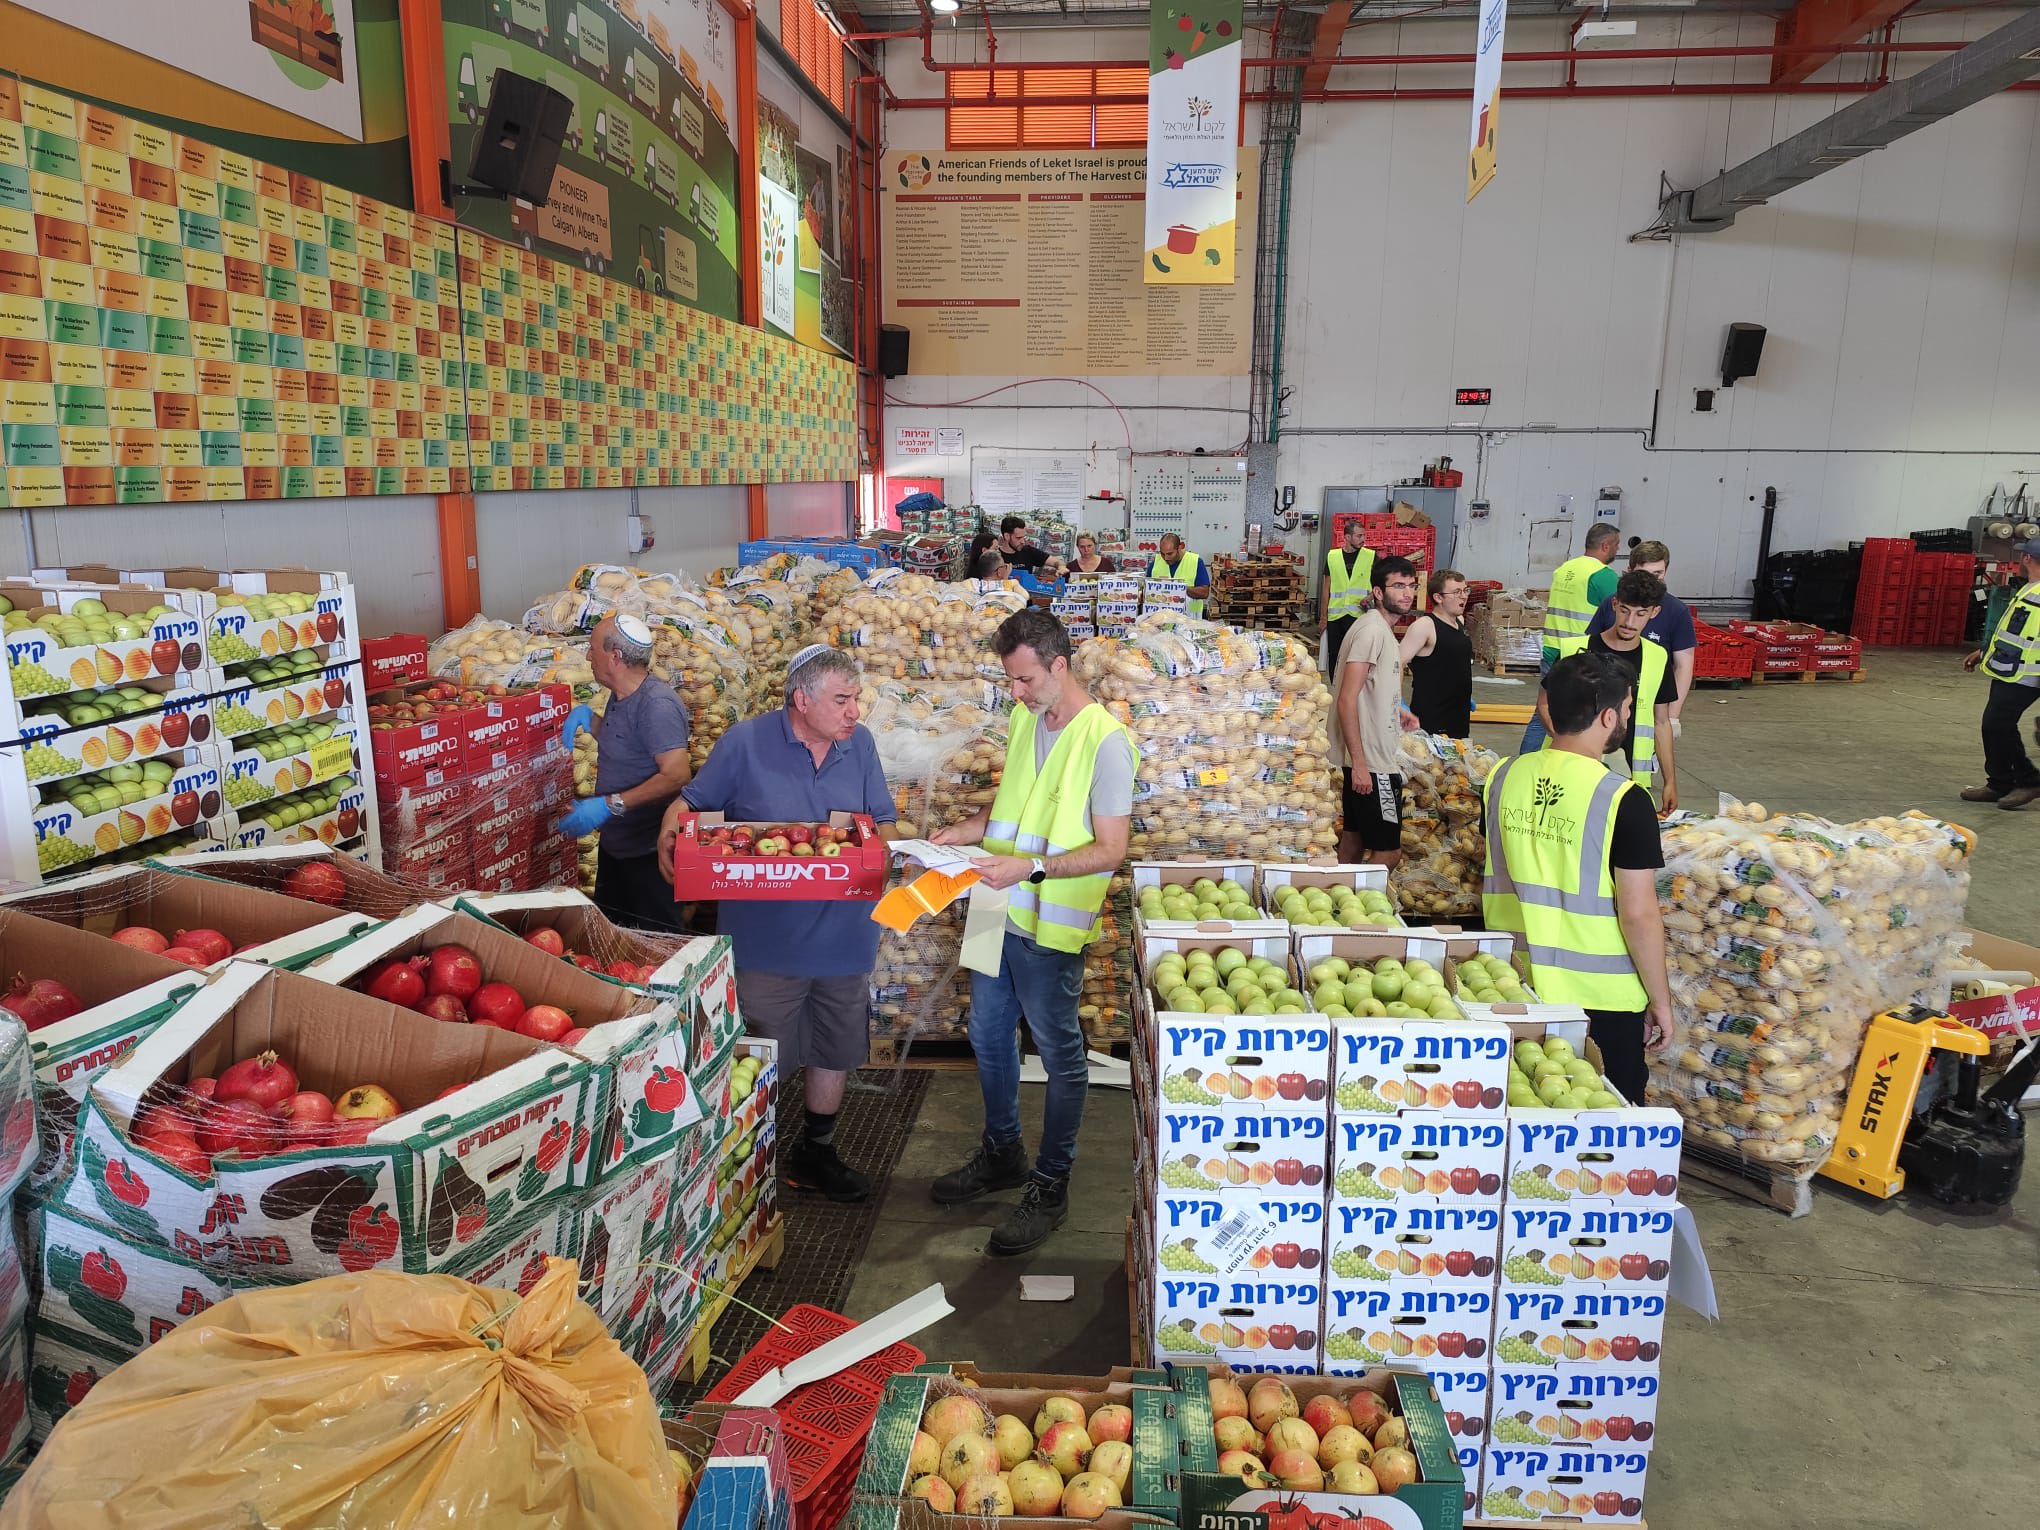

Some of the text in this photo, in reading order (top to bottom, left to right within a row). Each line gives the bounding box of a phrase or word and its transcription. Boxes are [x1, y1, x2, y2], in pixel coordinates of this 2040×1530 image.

[1163, 120, 1225, 134] לקט ישראל
[938, 157, 1147, 170] American Friends of Leket Israel is proud
[560, 181, 588, 203] PIONEER
[938, 172, 953, 182] the
[957, 172, 1001, 185] founding
[1005, 172, 1052, 182] members
[1056, 172, 1066, 181] of
[1068, 171, 1088, 181] The
[1091, 171, 1137, 181] Harvest
[1187, 175, 1219, 183] ישראל
[562, 202, 574, 216] and
[575, 206, 595, 224] Wynne
[552, 215, 599, 243] Calgary, Alberta
[1100, 582, 1114, 590] קיץ
[1148, 582, 1161, 590] קיץ
[218, 598, 342, 636] ירות קיץ
[1052, 604, 1066, 612] קיץ
[7, 620, 198, 666] פירות קיץ
[34, 770, 217, 841] פירות קיץ
[239, 792, 365, 848] ירות קיץ
[1548, 816, 1575, 833] לקט
[1166, 1027, 1328, 1056] פירות קיץ
[1343, 1035, 1507, 1064] פירות קיץ
[757, 1063, 778, 1090] פירות
[458, 1094, 564, 1158] ירקות מובחרים
[1165, 1114, 1324, 1143] פירות קיץ
[1342, 1123, 1503, 1151] פירות קיץ
[1518, 1124, 1681, 1153] פירות קיץ
[1165, 1200, 1322, 1228] פיר קיץ
[1338, 1206, 1499, 1235] פירות קיץ
[1512, 1210, 1673, 1238] פירות קיץ
[1226, 1254, 1244, 1274] תפוח
[1162, 1280, 1317, 1308] פירות קיץ
[1332, 1289, 1490, 1317] פירות קיץ
[1505, 1292, 1665, 1320] פירות קיץ
[1501, 1373, 1658, 1401] פירות קיץ
[1491, 1450, 1647, 1477] פירות קיץ
